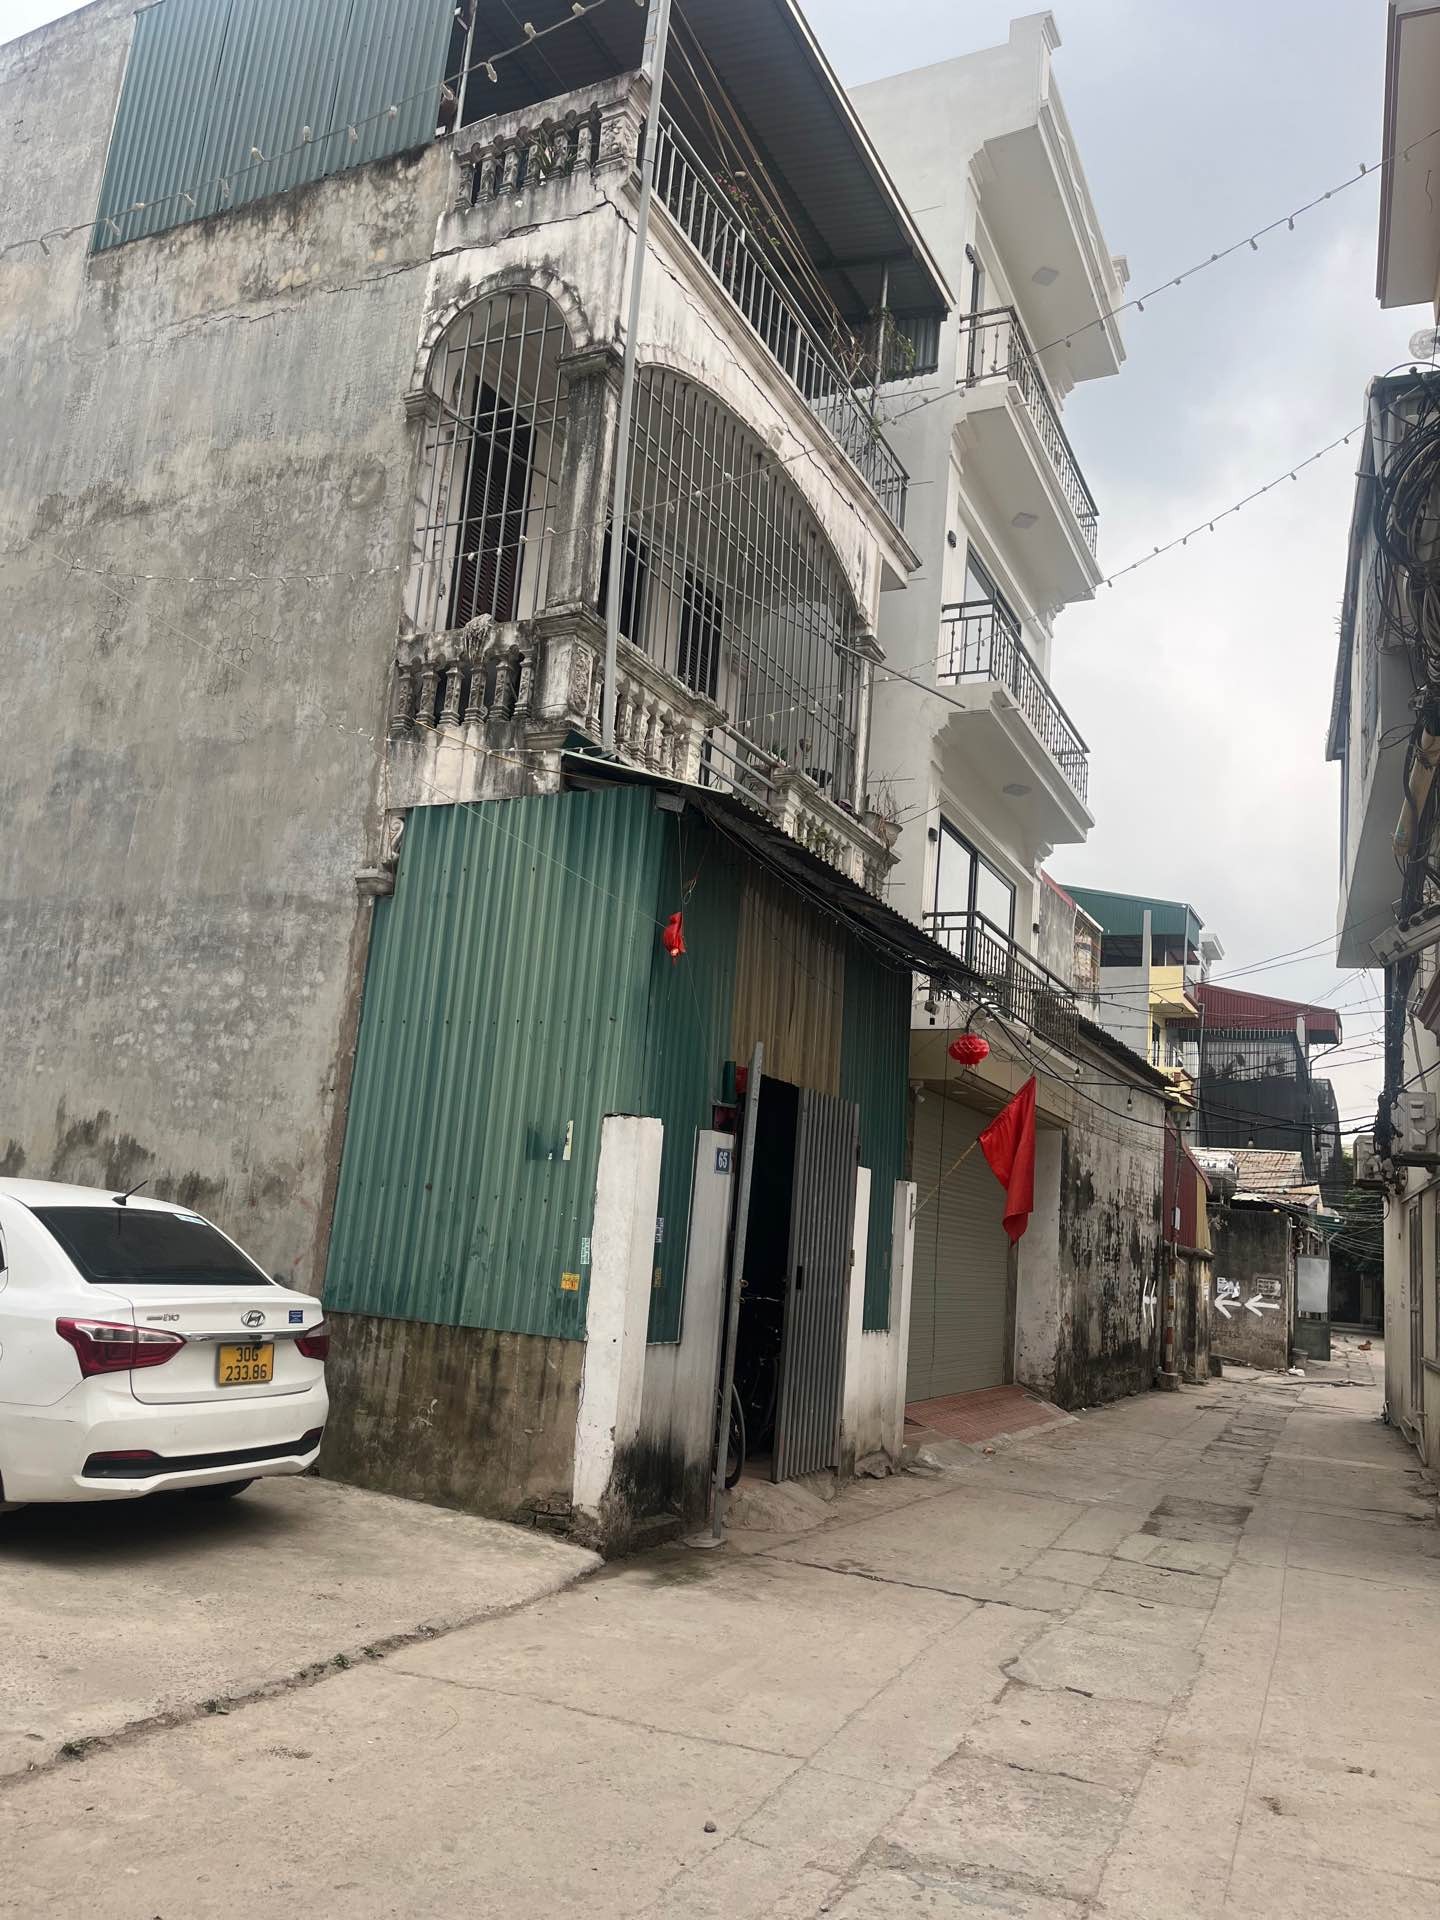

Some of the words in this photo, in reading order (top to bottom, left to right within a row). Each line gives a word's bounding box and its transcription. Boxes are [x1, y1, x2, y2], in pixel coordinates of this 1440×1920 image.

[718, 1151, 728, 1168] 65
[236, 1346, 259, 1362] 30G
[225, 1364, 267, 1381] 233.86
